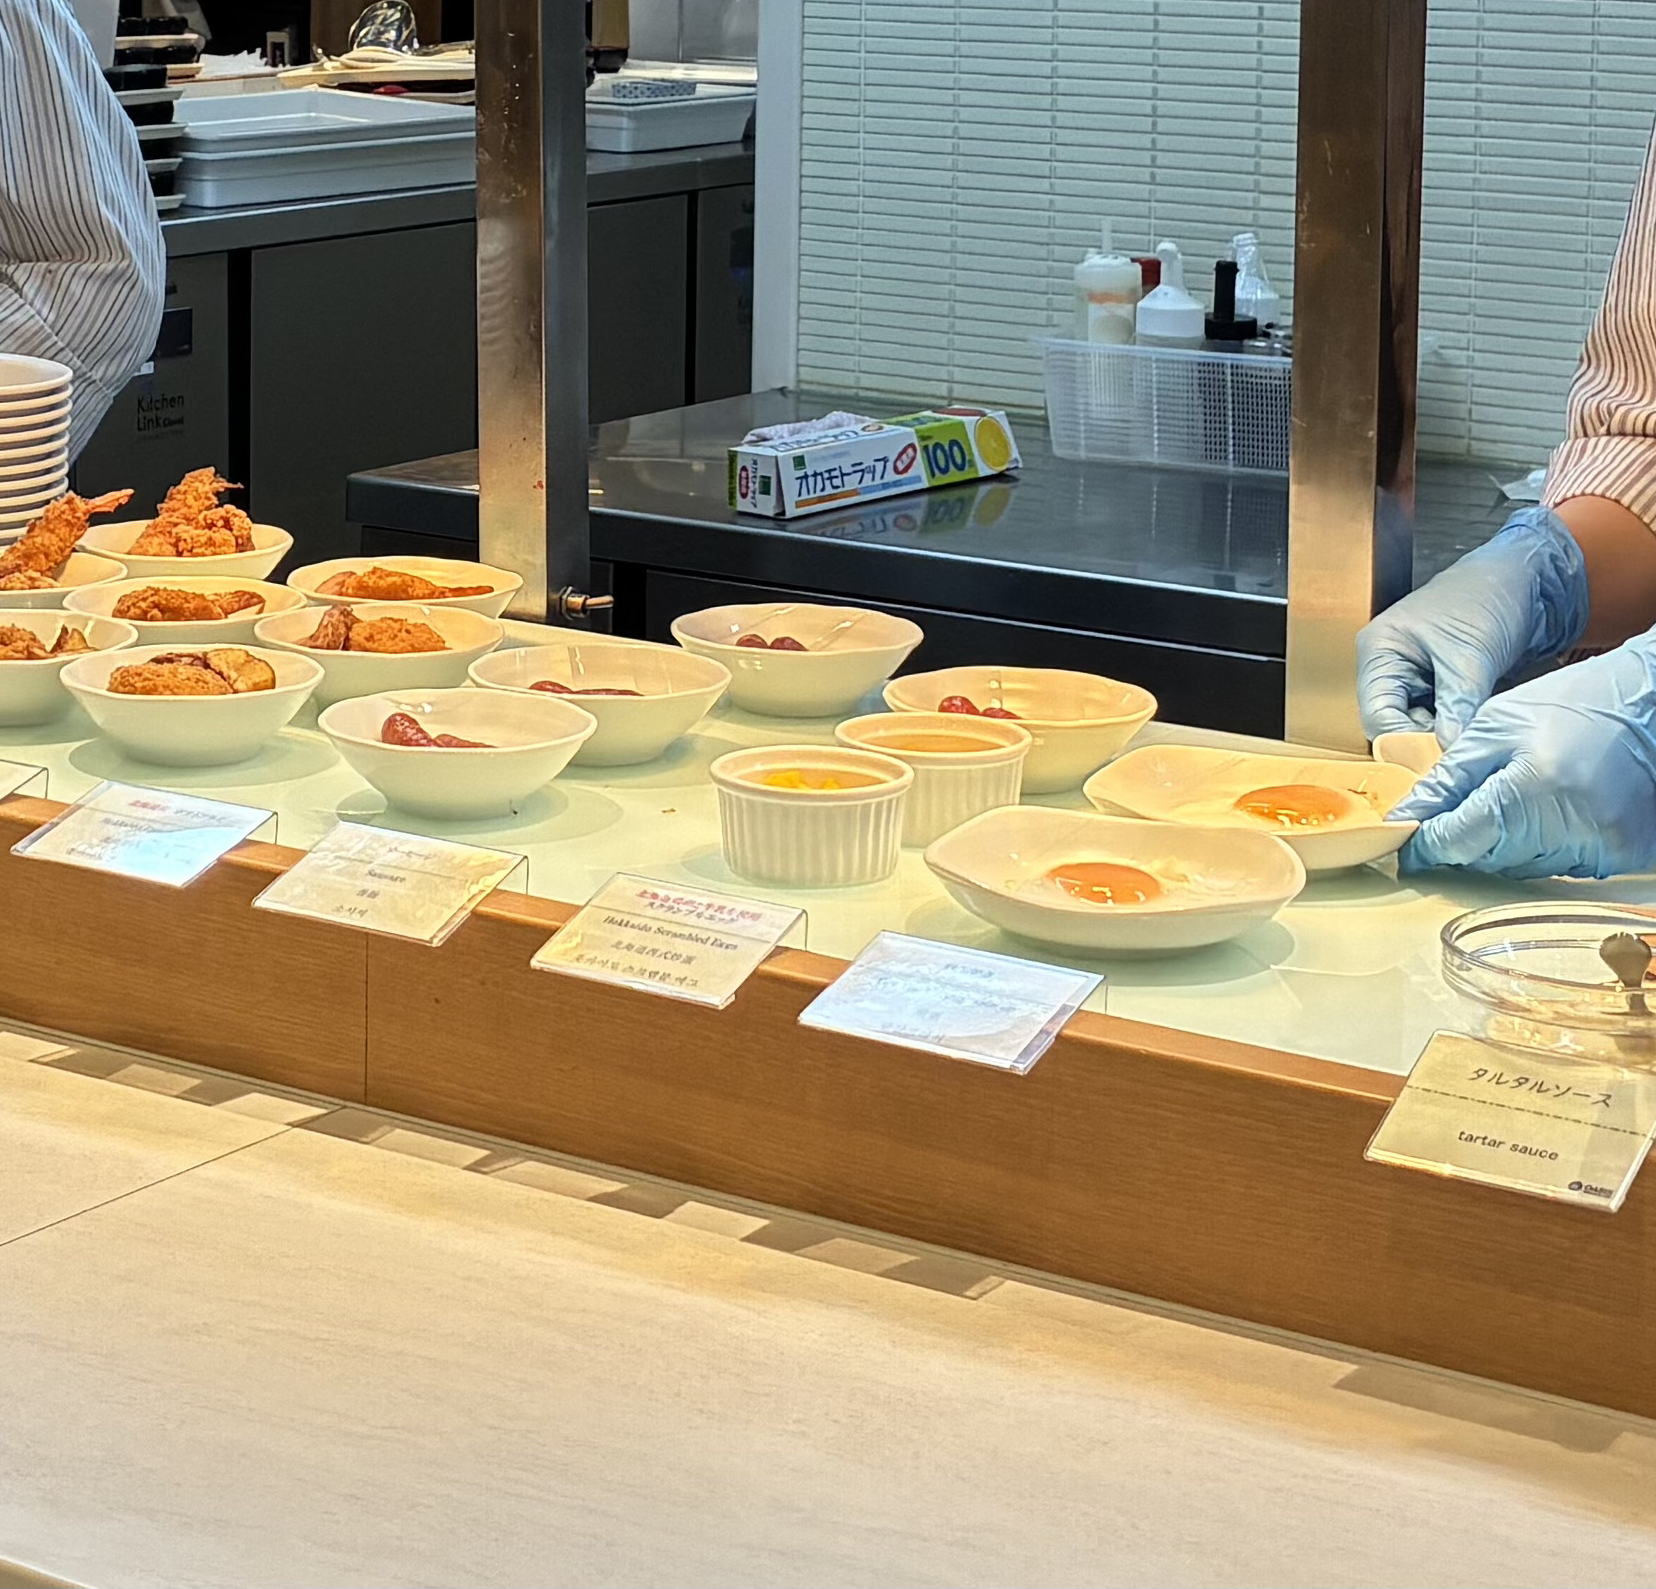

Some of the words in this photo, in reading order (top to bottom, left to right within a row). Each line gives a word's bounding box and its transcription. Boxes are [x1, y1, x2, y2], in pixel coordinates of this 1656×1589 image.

[795, 456, 891, 498] オカモトラップ
[924, 439, 967, 479] 100
[1468, 1067, 1613, 1108] タルタルソース
[1458, 1130, 1506, 1149] tartar
[1509, 1142, 1559, 1161] sauce
